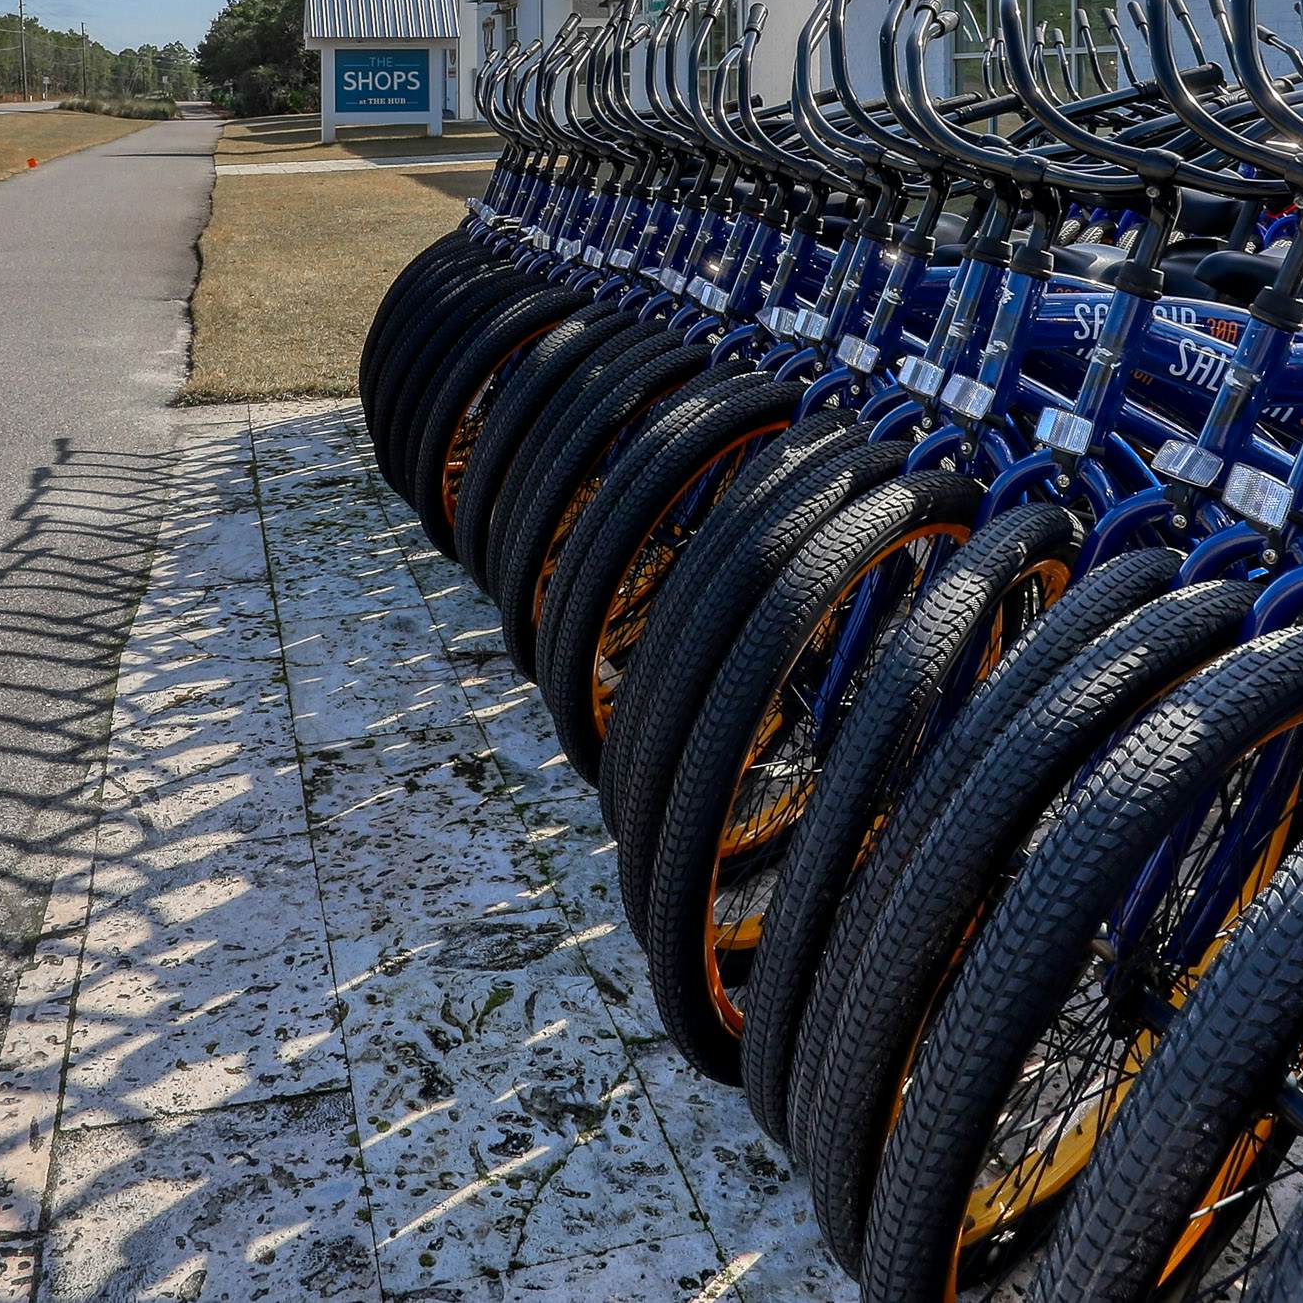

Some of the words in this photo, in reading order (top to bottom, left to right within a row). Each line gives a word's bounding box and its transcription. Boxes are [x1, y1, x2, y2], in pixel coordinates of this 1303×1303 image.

[370, 57, 393, 67] THE
[343, 71, 420, 91] SHOPS
[1169, 338, 1230, 392] SAL
